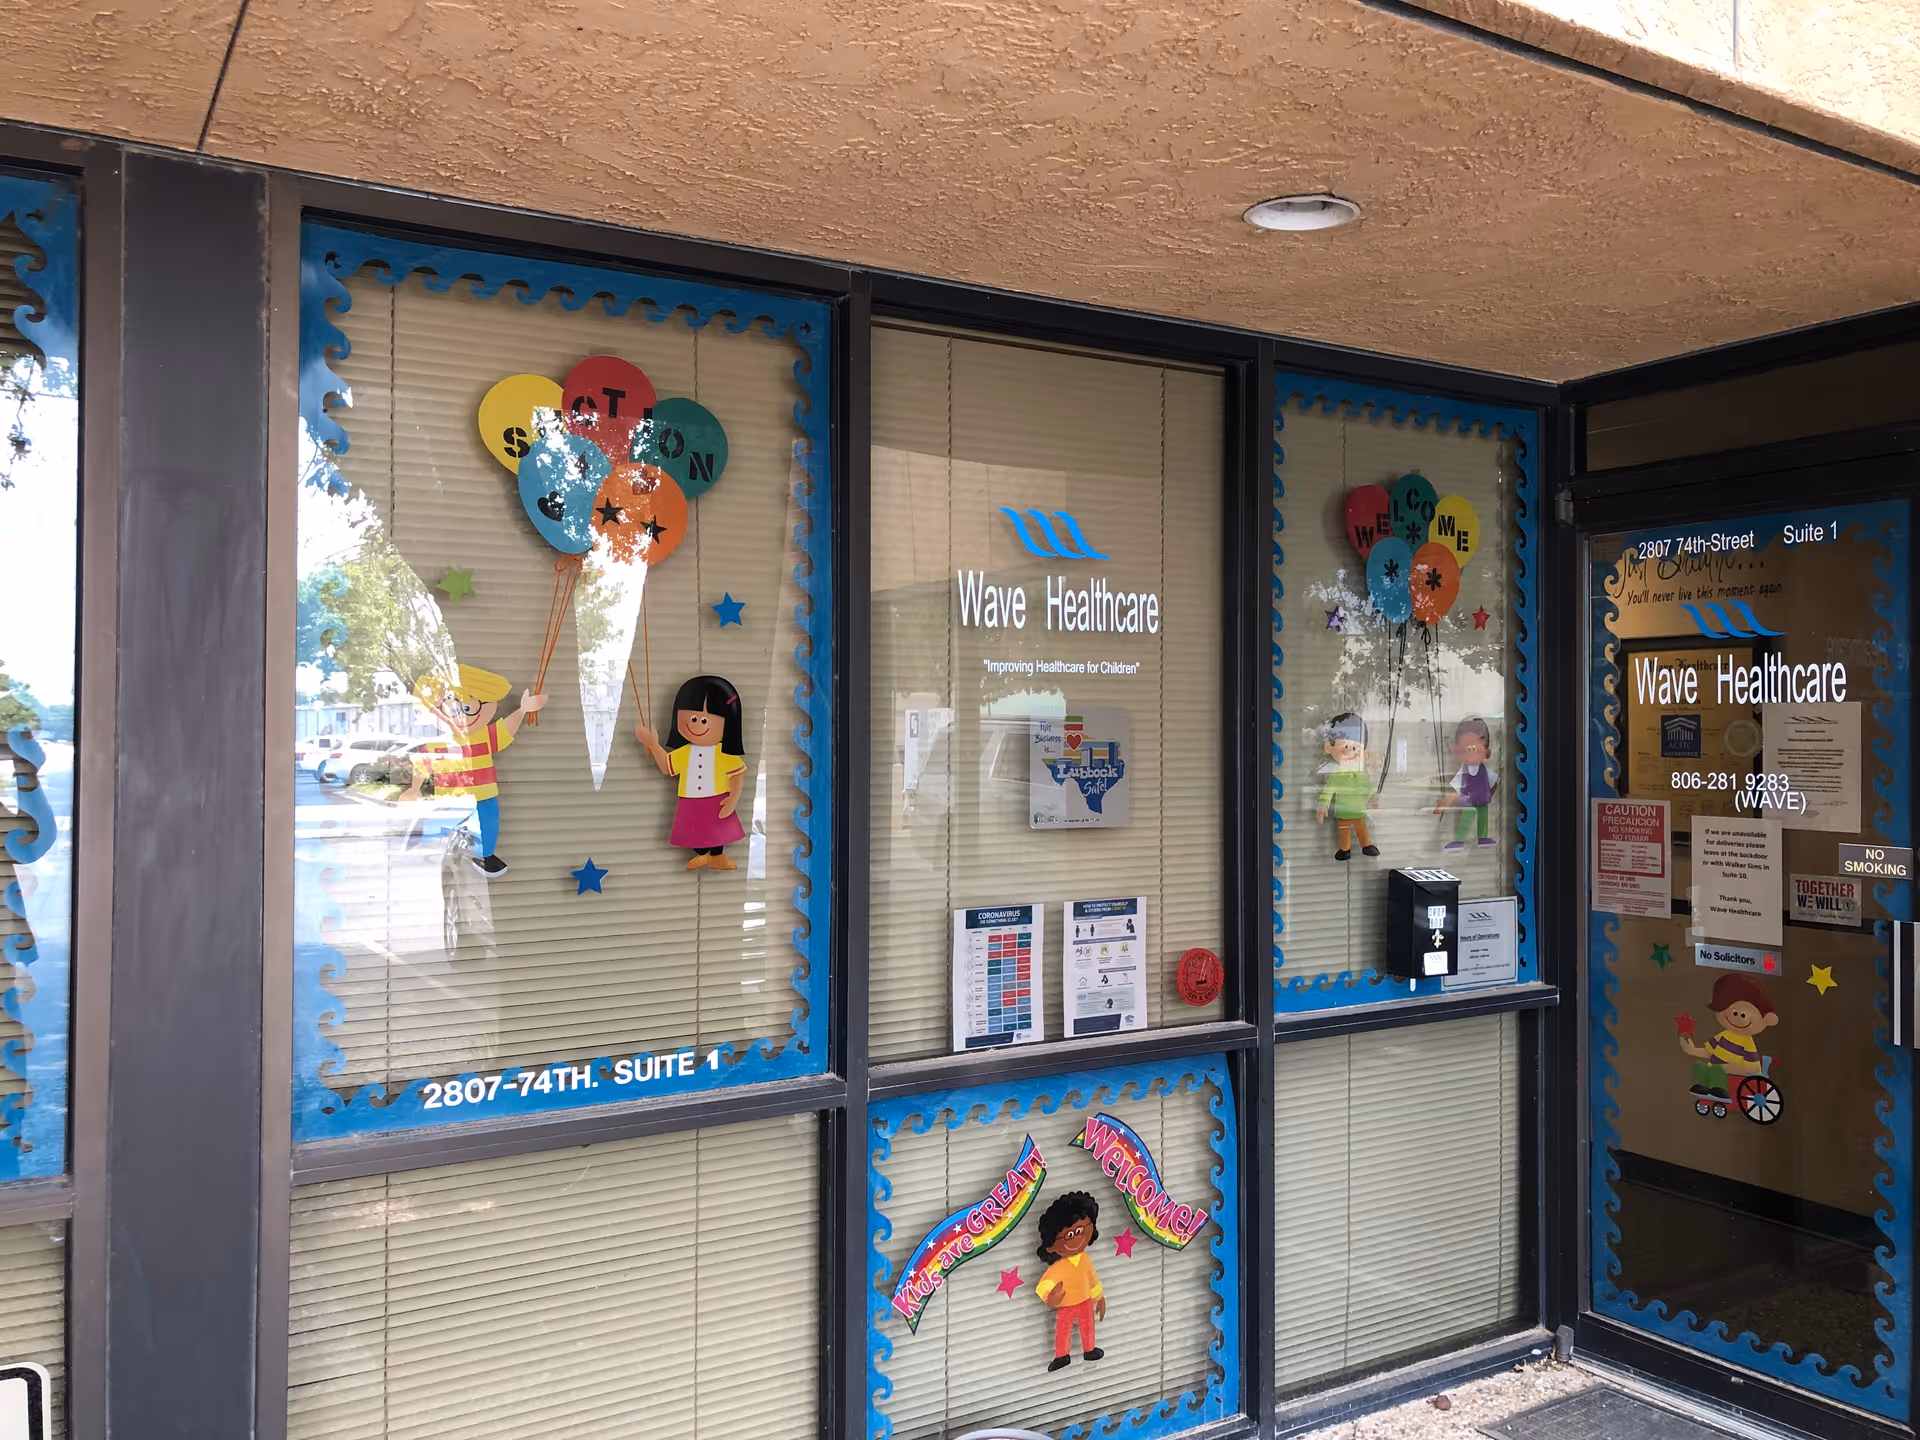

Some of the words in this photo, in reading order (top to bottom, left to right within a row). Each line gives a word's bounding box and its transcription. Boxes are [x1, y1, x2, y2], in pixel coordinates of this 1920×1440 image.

[1354, 488, 1469, 552] WELCOME
[1784, 524, 1824, 544] Suite
[1830, 520, 1838, 540] 1
[1638, 539, 1672, 560] 2807
[1676, 530, 1754, 555] 74th-Street
[958, 570, 1026, 629] Wave
[1047, 575, 1159, 634] Healthcare
[1628, 590, 1649, 606] You'll
[1652, 592, 1674, 604] never
[1678, 587, 1692, 600] live
[1696, 586, 1712, 598] this
[1717, 585, 1754, 598] moment
[1759, 583, 1782, 596] again
[983, 660, 1034, 676] "Improving
[1036, 660, 1084, 674] Healthcare
[1087, 661, 1099, 674] for
[1100, 661, 1140, 674] Children"
[1635, 656, 1698, 704] Wave
[1717, 652, 1847, 704] Healthcare
[1057, 764, 1118, 779] Lubbock
[1083, 778, 1108, 796] Safe!
[1672, 772, 1737, 790] 806-281
[1745, 773, 1790, 792] 9283
[1606, 804, 1656, 816] CAUTION
[1735, 791, 1807, 814] (WAVE)
[1602, 816, 1659, 826] PRECAUCION
[1732, 830, 1767, 838] unavailable
[1716, 840, 1745, 848] deliveries
[1740, 852, 1768, 860] backdoor
[1866, 848, 1884, 860] NO
[1844, 860, 1906, 876] SMOKING
[1796, 880, 1854, 898] TOGETHER
[1719, 894, 1738, 902] Thank
[1798, 894, 1813, 908] WE
[1816, 896, 1842, 911] WILL
[978, 910, 1020, 920] CORONAVIRUS
[1728, 908, 1762, 917] Healthcare
[1700, 950, 1712, 960] No
[1714, 952, 1756, 965] Solicitors
[423, 1064, 599, 1109] 2807-74TH.
[614, 1052, 695, 1084] SUITE
[706, 1050, 718, 1070] 1
[892, 1267, 944, 1320] Kids
[937, 1233, 976, 1270] are
[966, 1146, 1048, 1234] GREAT!
